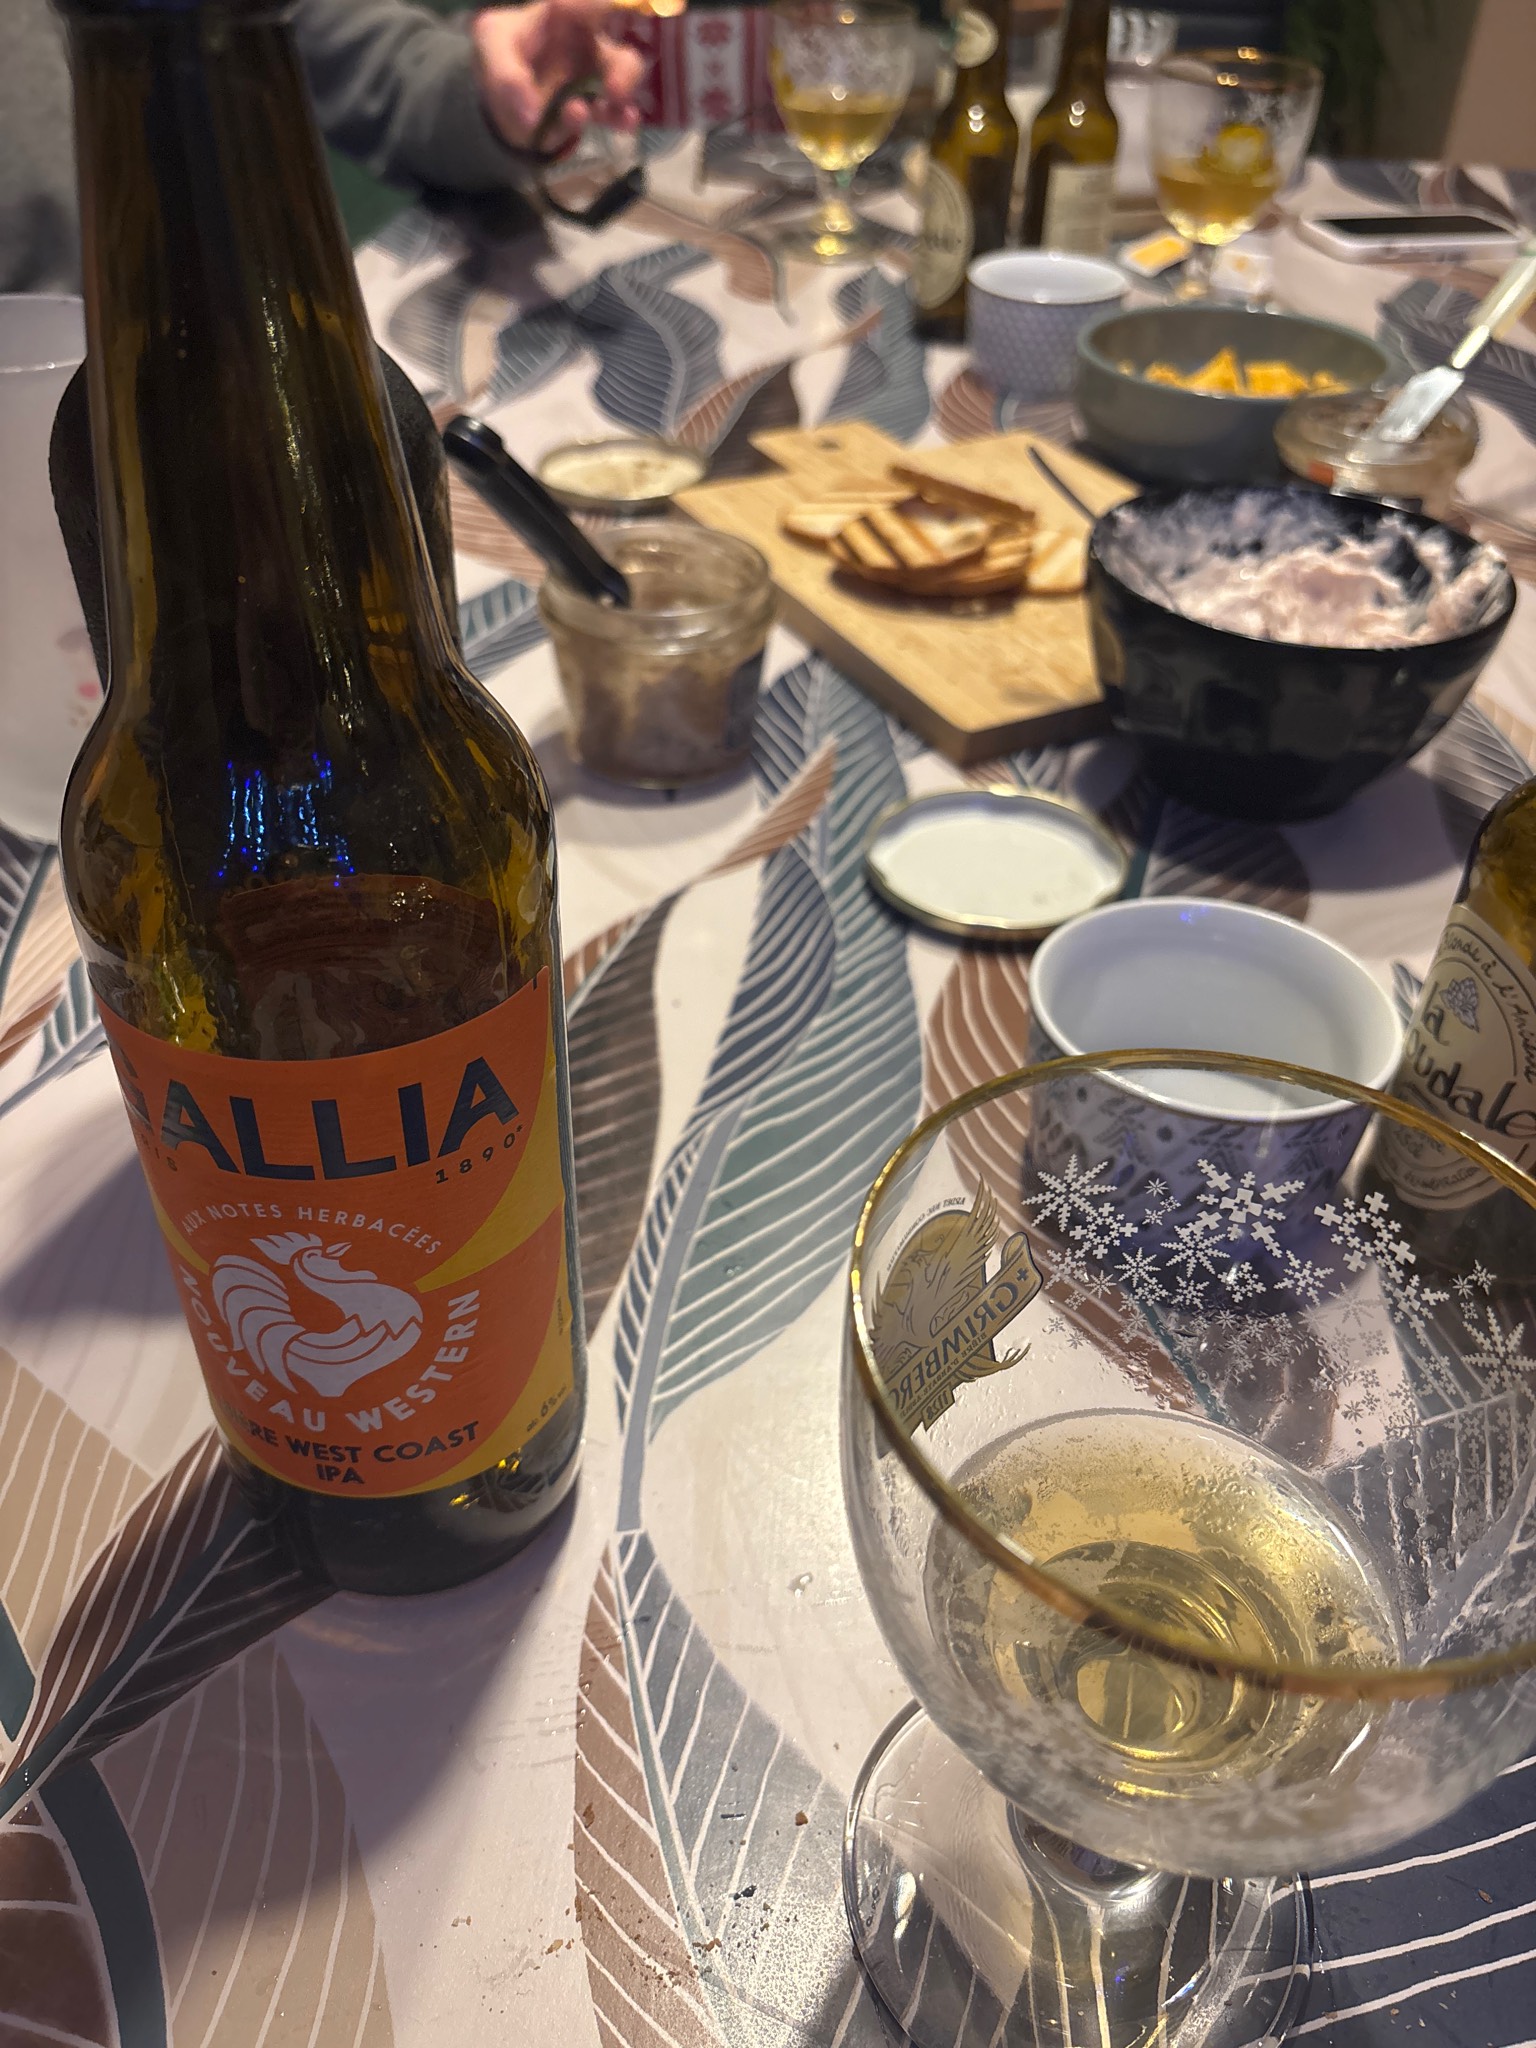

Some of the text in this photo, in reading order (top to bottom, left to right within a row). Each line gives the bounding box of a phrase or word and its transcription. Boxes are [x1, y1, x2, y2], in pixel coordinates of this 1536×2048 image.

[1406, 1029, 1536, 1139] oudale
[181, 1202, 442, 1255] AUX NOTES HERBACÉES
[179, 1263, 480, 1433] NOUVEAU WESTERN
[284, 1434, 362, 1463] WEST
[373, 1421, 480, 1463] COAST
[316, 1463, 365, 1485] IPA
